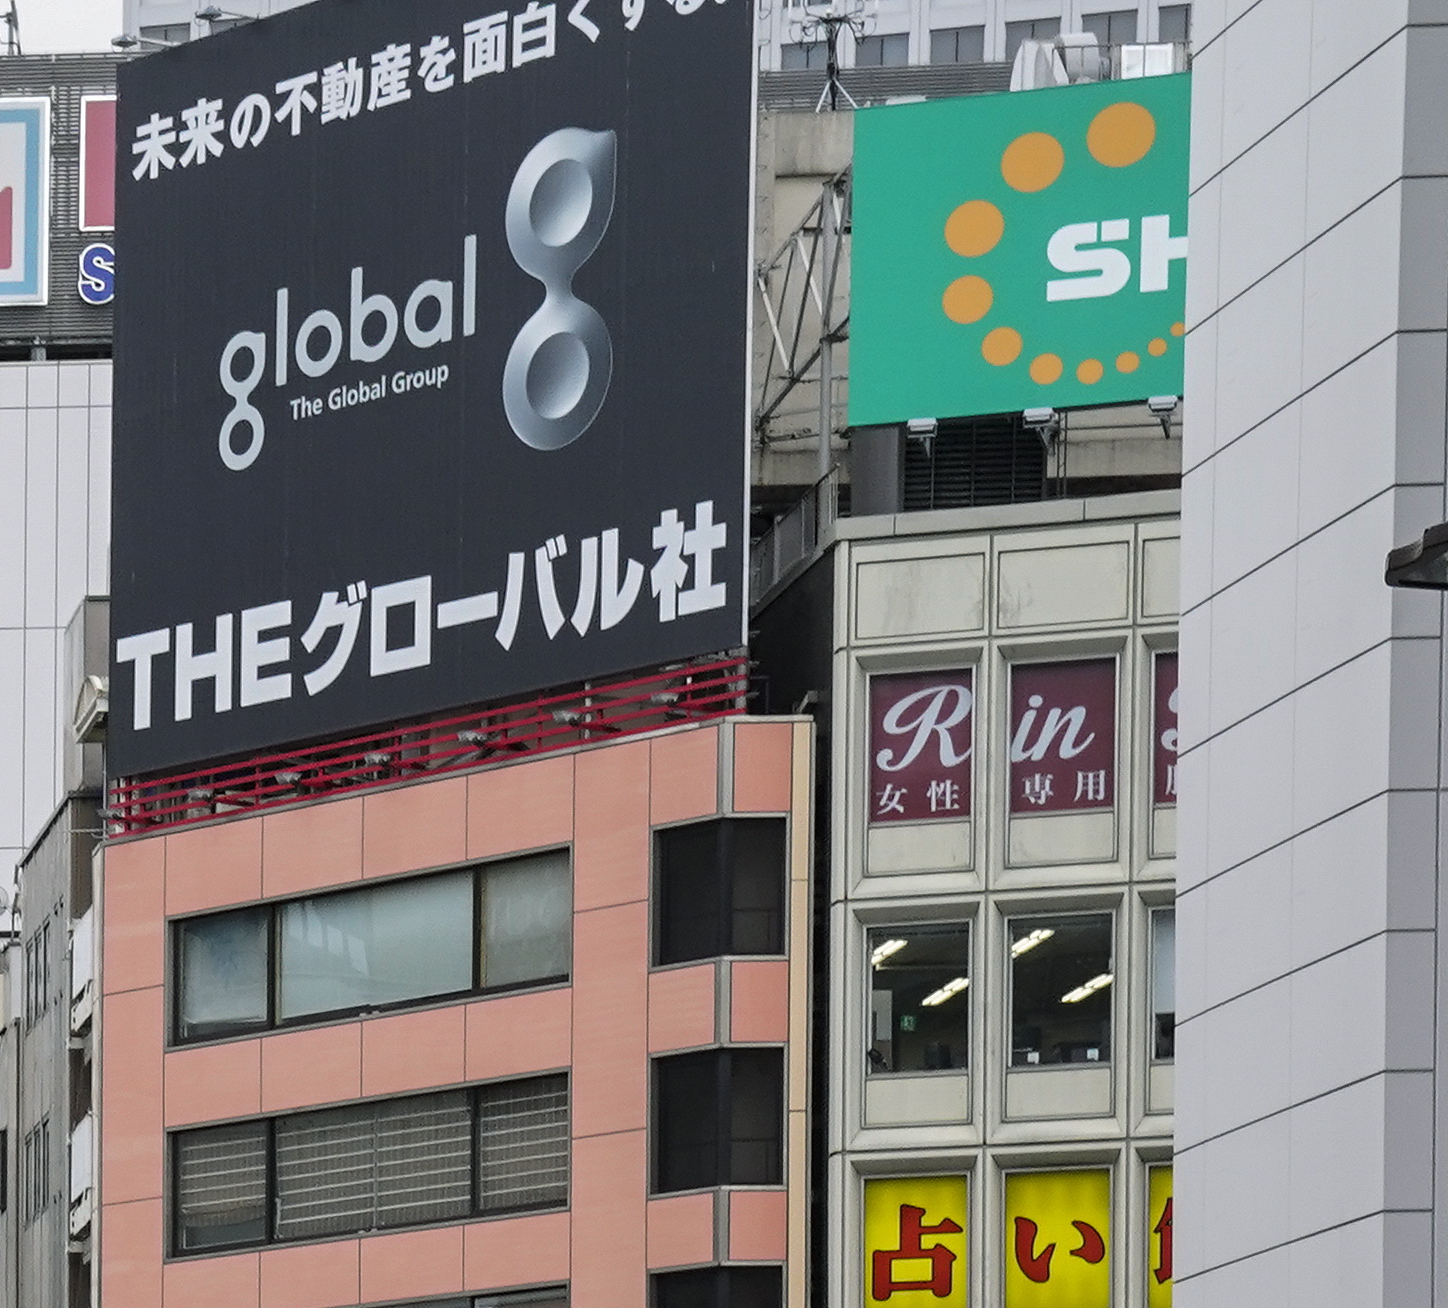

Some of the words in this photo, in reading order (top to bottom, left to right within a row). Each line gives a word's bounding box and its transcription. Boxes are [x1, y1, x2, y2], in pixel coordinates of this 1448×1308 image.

[220, 234, 477, 473] global
[290, 397, 325, 421] The
[328, 378, 387, 412] Global
[392, 364, 449, 401] Group
[115, 500, 729, 732] THEグローバル社
